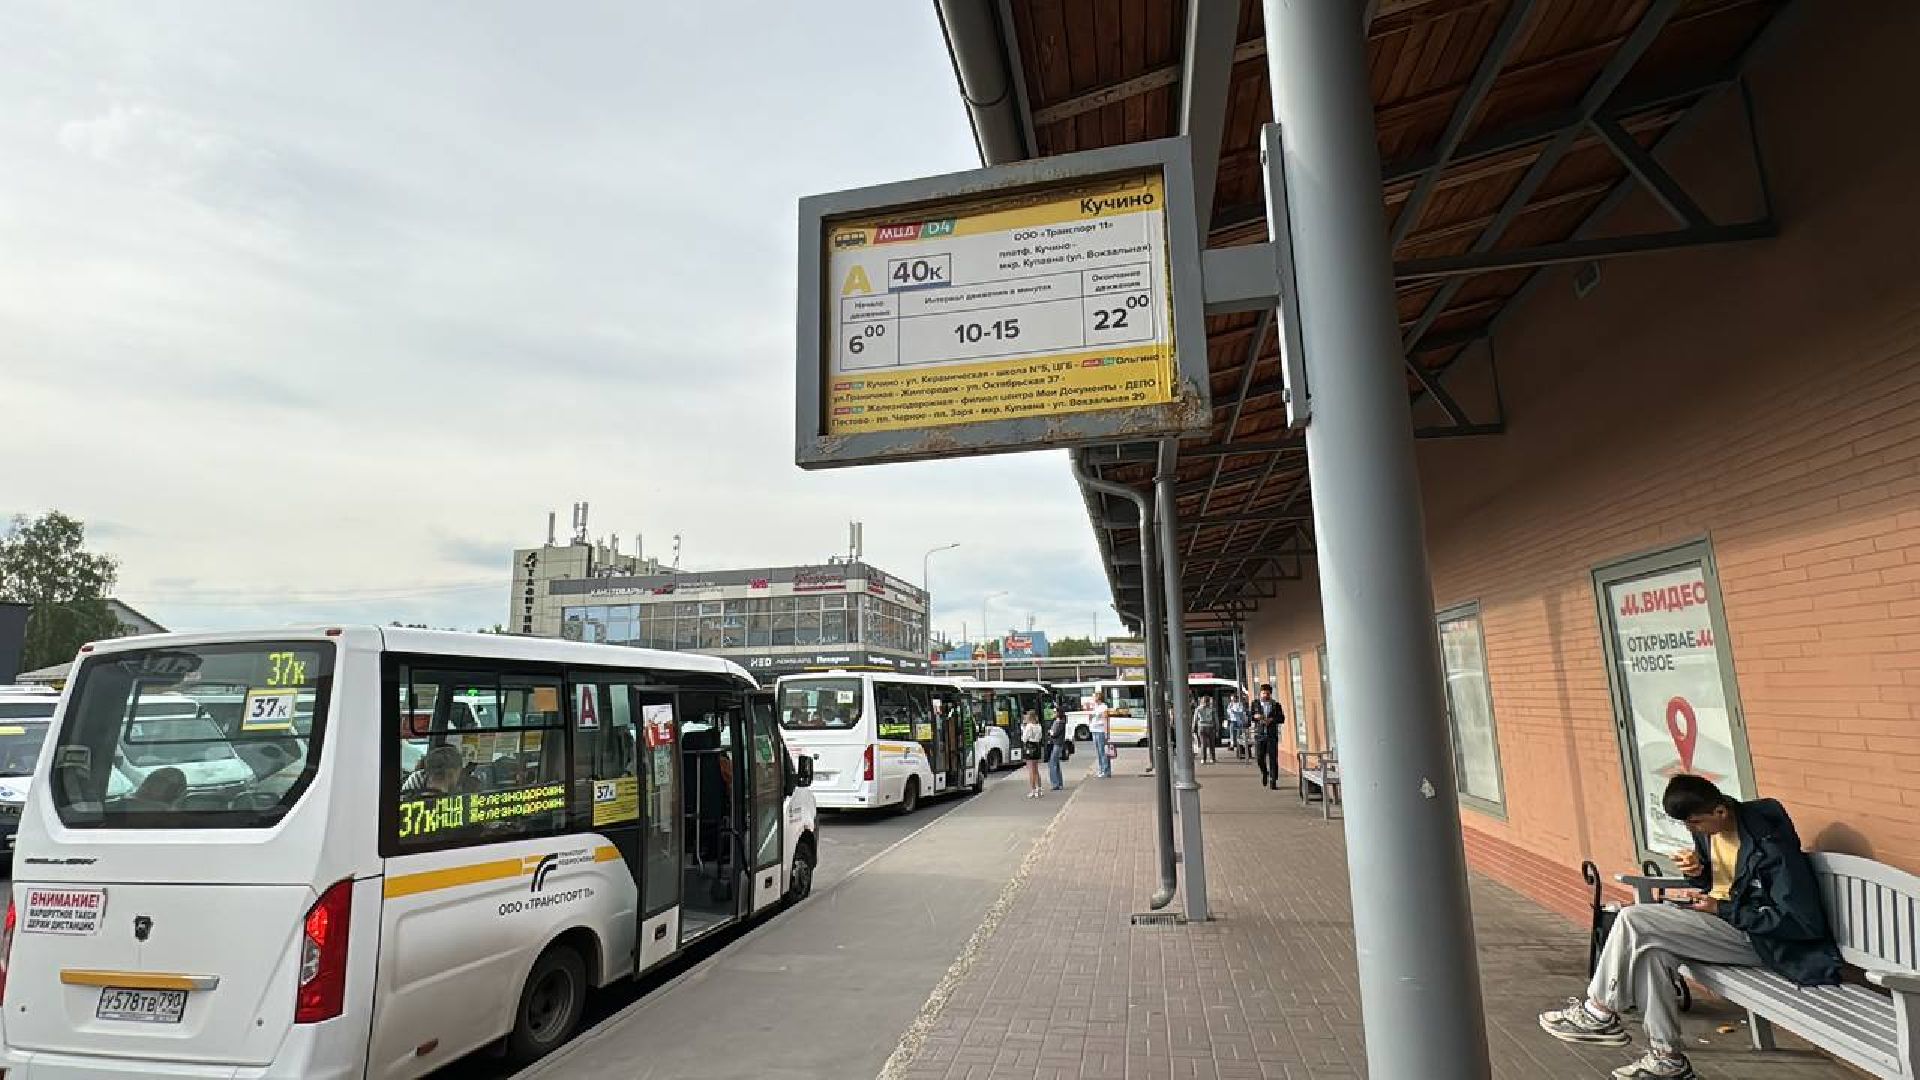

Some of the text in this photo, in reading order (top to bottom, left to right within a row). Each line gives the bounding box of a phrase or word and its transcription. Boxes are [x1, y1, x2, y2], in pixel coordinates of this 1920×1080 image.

[1080, 193, 1154, 215] Кучино
[879, 225, 915, 239] МЦД
[1013, 230, 1038, 241] ООО
[1040, 224, 1096, 239] «Транспорт
[1023, 256, 1063, 268] Купавна
[1086, 243, 1152, 259] Вокзальная)
[1034, 243, 1071, 255] Кучино
[842, 264, 872, 295] А
[893, 260, 943, 283] 40к
[1092, 270, 1141, 282] Окончание
[955, 318, 1020, 343] 10-15
[1116, 354, 1159, 365] Ольгино
[1060, 383, 1117, 397] Документы
[1126, 378, 1156, 390] ДЕПО
[1628, 630, 1713, 652] ОТКРЫВАЕМ
[1631, 654, 1675, 672] НОВОЕ
[252, 697, 287, 717] 37к
[31, 891, 100, 908] ВНИМАНИЕ!
[499, 901, 522, 915] ООО
[525, 889, 582, 909] «ТРАНСПОРТ
